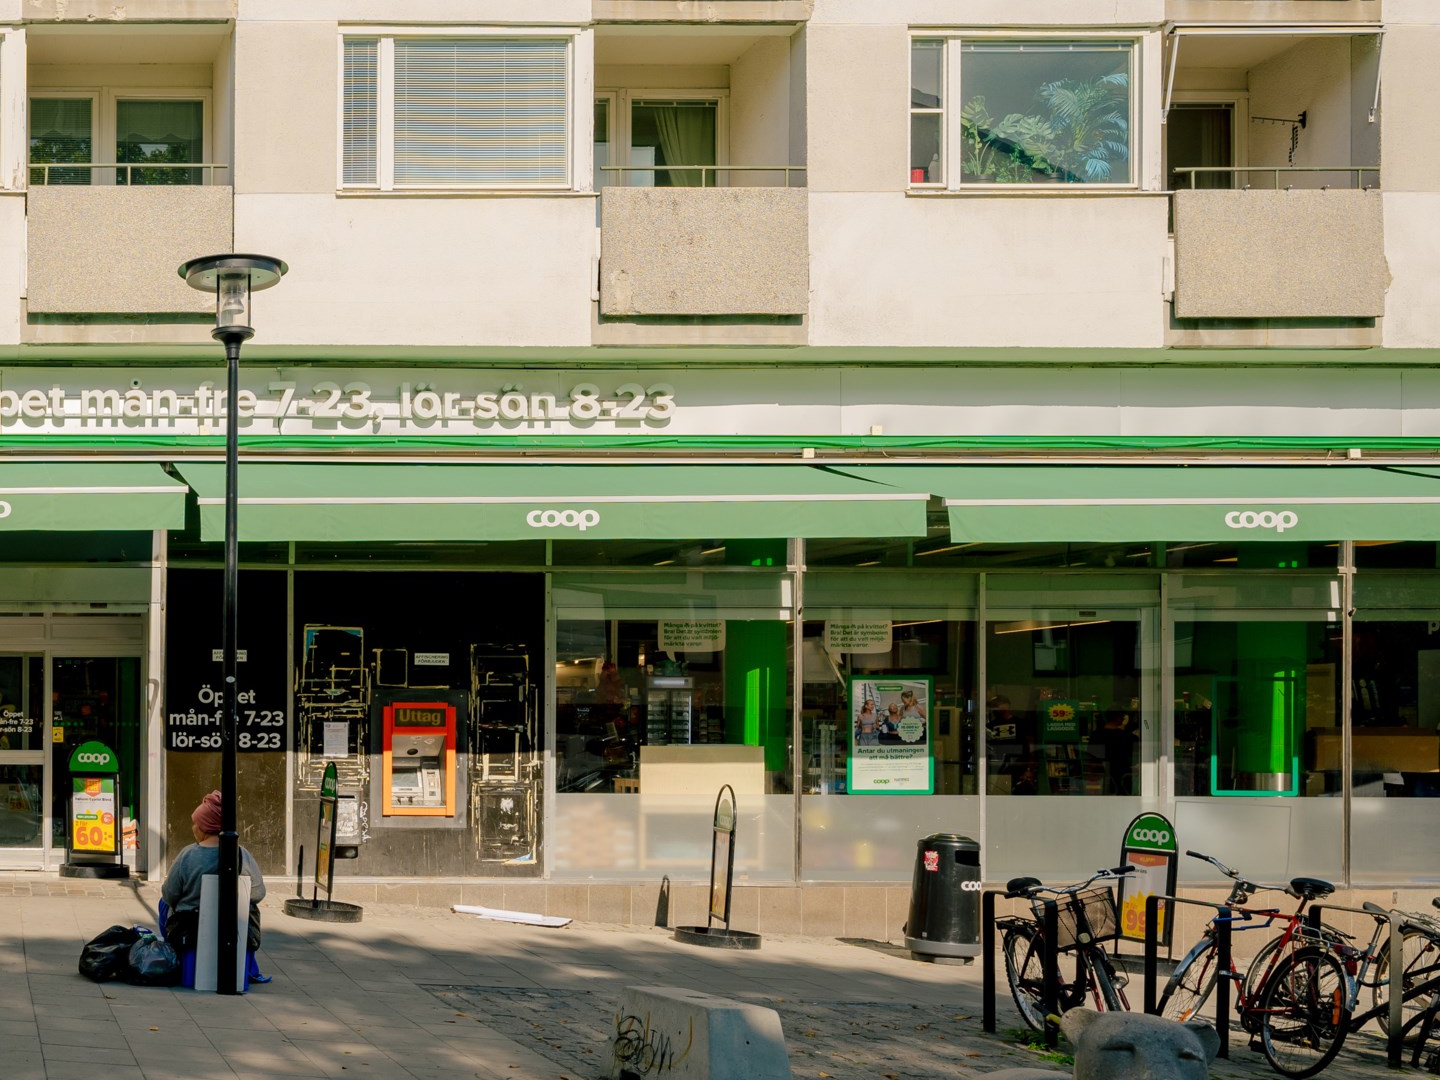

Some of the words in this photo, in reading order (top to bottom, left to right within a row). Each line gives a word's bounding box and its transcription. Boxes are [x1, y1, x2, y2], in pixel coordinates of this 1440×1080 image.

[80, 376, 257, 419] mån-fre
[267, 380, 385, 424] 7-23,
[399, 380, 556, 420] lör-sön
[568, 381, 678, 420] 8-23
[526, 509, 601, 531] coop
[1224, 510, 1299, 533] coop
[198, 684, 256, 708] Öpet
[3, 709, 24, 718] Öppet
[169, 708, 240, 726] mån-f
[244, 710, 284, 727] 7-23
[399, 709, 441, 726] Uttag
[172, 731, 223, 748] lör-sö
[238, 732, 281, 749] 8-23
[77, 752, 110, 766] coop
[886, 747, 925, 755] utmaningen
[1132, 828, 1170, 846] coop
[960, 880, 982, 891] coo
